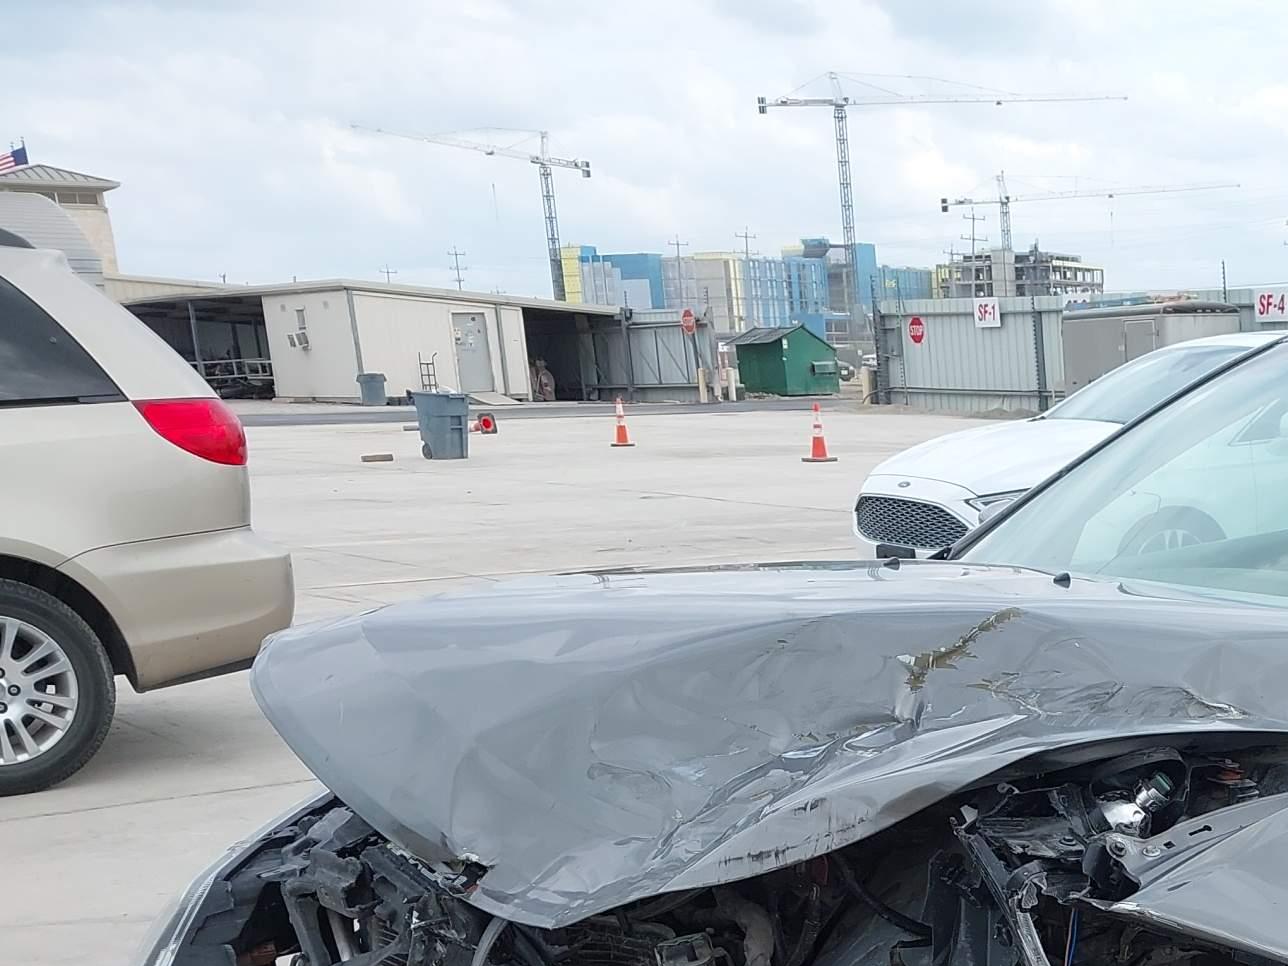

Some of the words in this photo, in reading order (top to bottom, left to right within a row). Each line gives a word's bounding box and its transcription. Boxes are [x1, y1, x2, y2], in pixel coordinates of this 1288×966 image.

[978, 303, 996, 322] SF-1
[1258, 293, 1286, 316] SF-4
[910, 325, 924, 336] STOP
